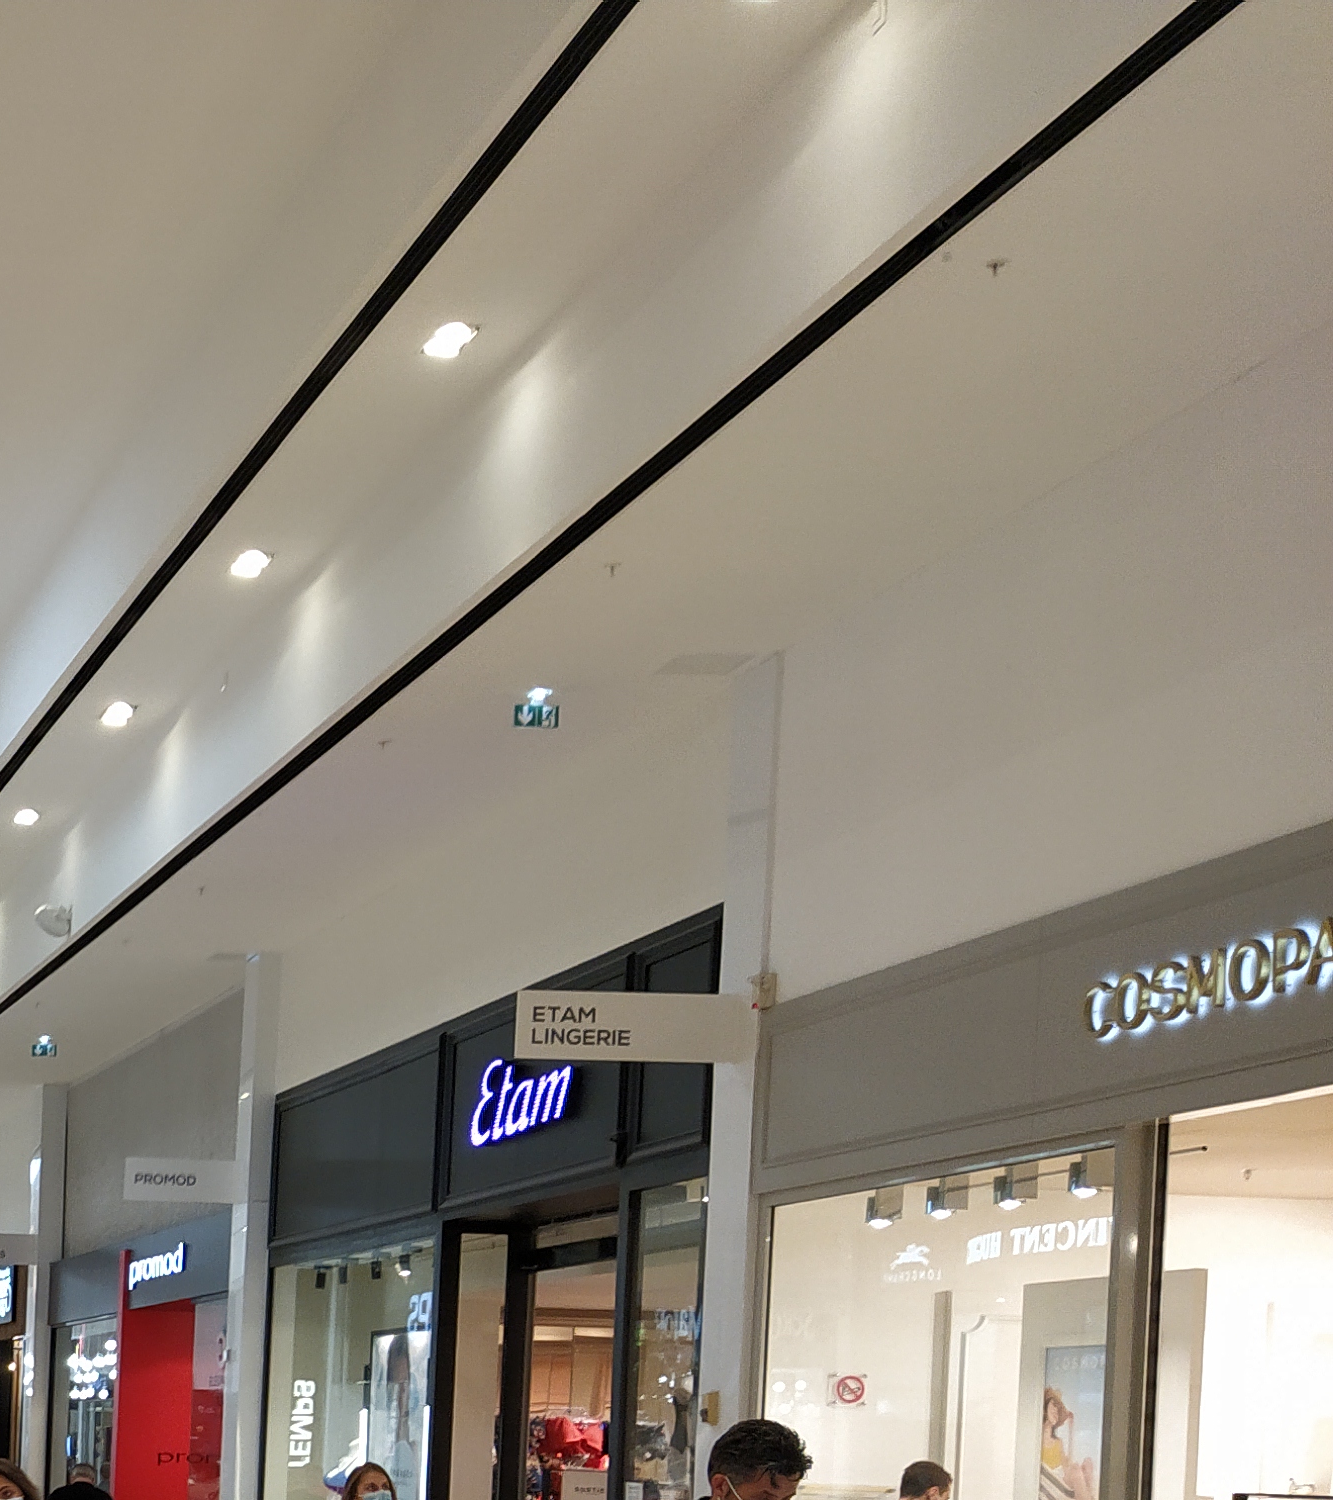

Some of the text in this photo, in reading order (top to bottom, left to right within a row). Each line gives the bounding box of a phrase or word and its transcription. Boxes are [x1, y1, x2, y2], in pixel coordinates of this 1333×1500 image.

[1083, 916, 1333, 1038] COSMOPA
[532, 1005, 597, 1024] ETAM
[531, 1028, 632, 1046] LINGERIE
[470, 1058, 574, 1147] Etam
[134, 1173, 197, 1187] PROMOD
[128, 1241, 186, 1291] promod
